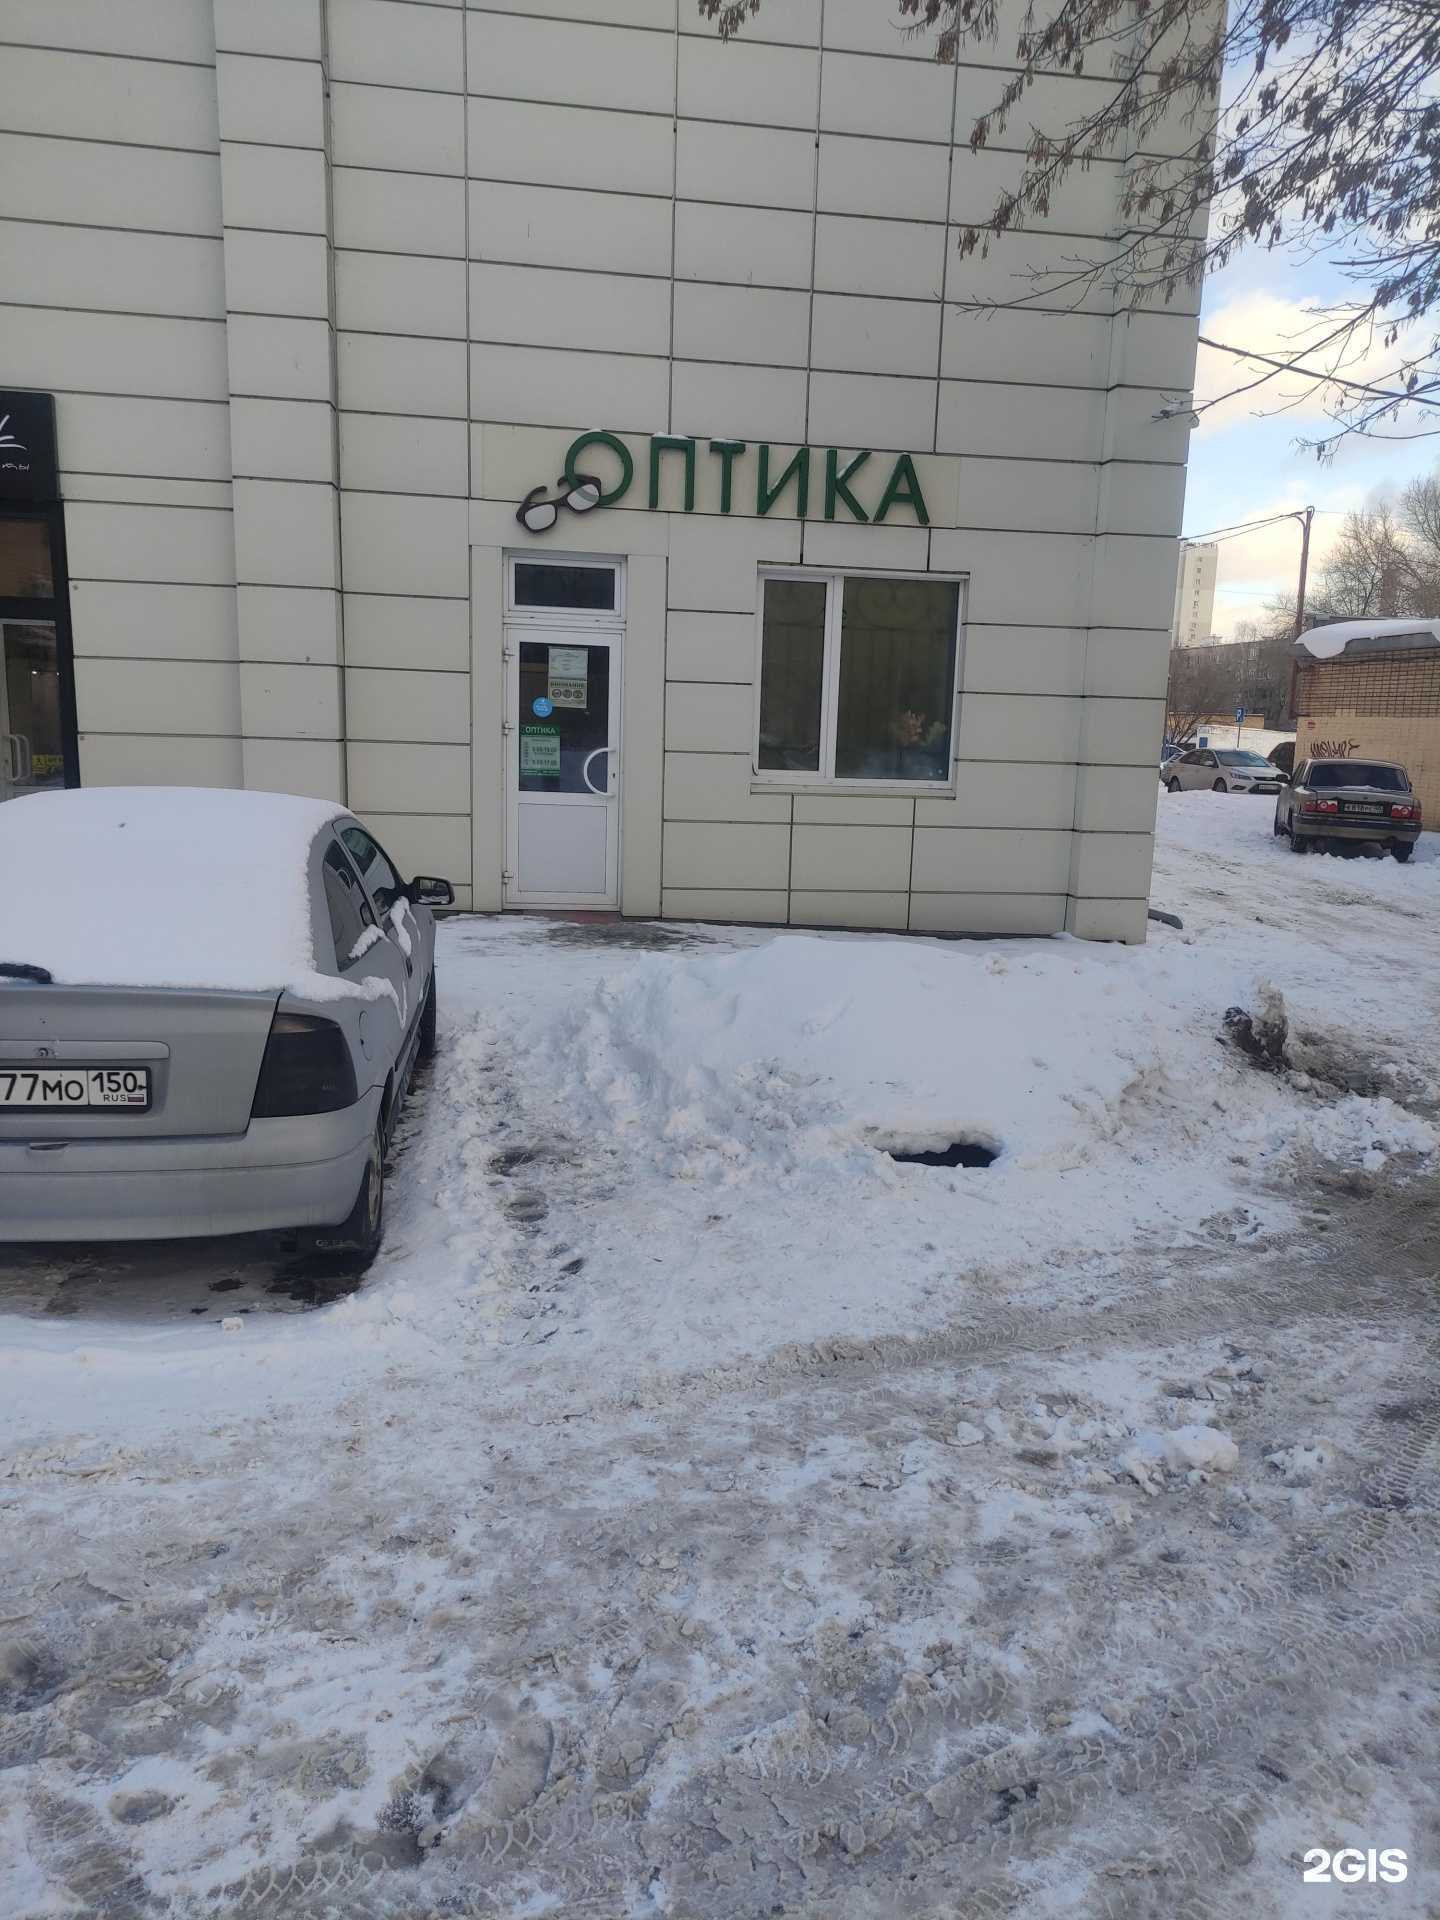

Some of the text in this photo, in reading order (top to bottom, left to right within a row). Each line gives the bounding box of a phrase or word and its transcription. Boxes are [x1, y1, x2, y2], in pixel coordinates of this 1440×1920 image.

[564, 430, 930, 525] ОПТИКА
[525, 726, 556, 735] ОПТИКА
[91, 1071, 138, 1093] 150
[103, 1094, 127, 1102] RUS
